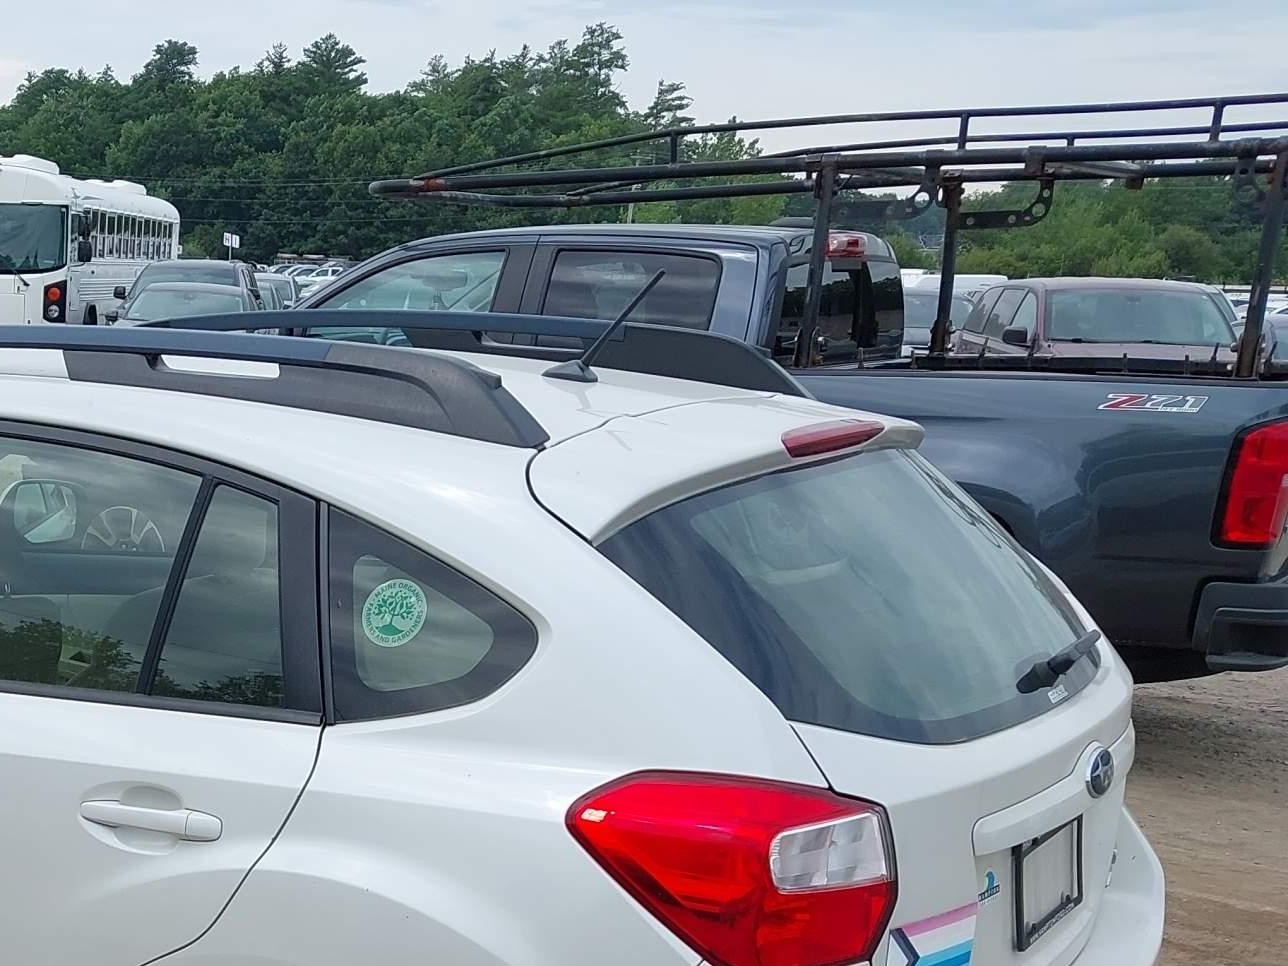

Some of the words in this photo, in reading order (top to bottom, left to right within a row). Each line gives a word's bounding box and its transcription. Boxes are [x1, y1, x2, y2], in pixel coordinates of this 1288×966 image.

[1097, 393, 1209, 413] Z71
[374, 583, 397, 597] MAINE
[398, 582, 423, 604] ORGANIC
[375, 633, 390, 643] AND
[391, 610, 424, 643] GARDENERS
